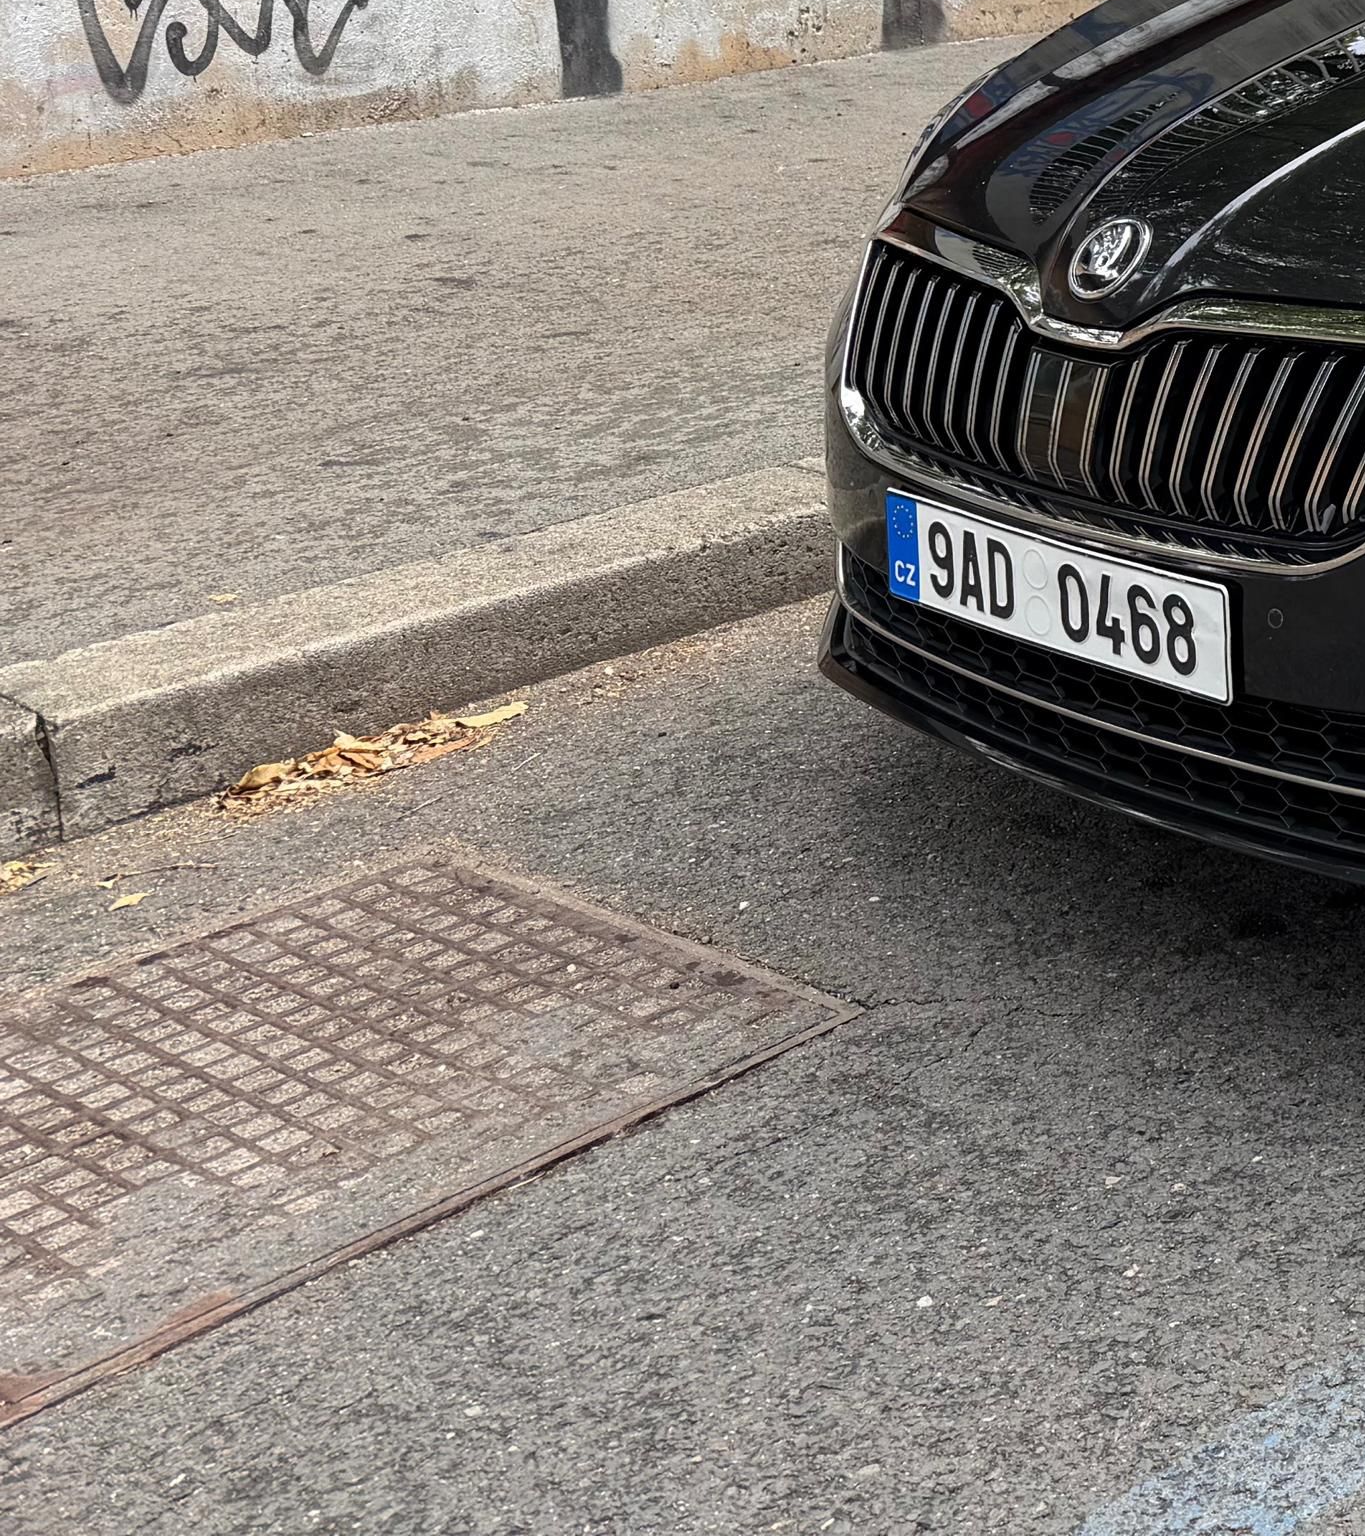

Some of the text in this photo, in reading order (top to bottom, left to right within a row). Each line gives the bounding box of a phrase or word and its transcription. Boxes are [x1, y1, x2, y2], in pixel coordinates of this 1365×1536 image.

[894, 560, 917, 587] CZ
[927, 520, 1198, 677] 9AD 0468
